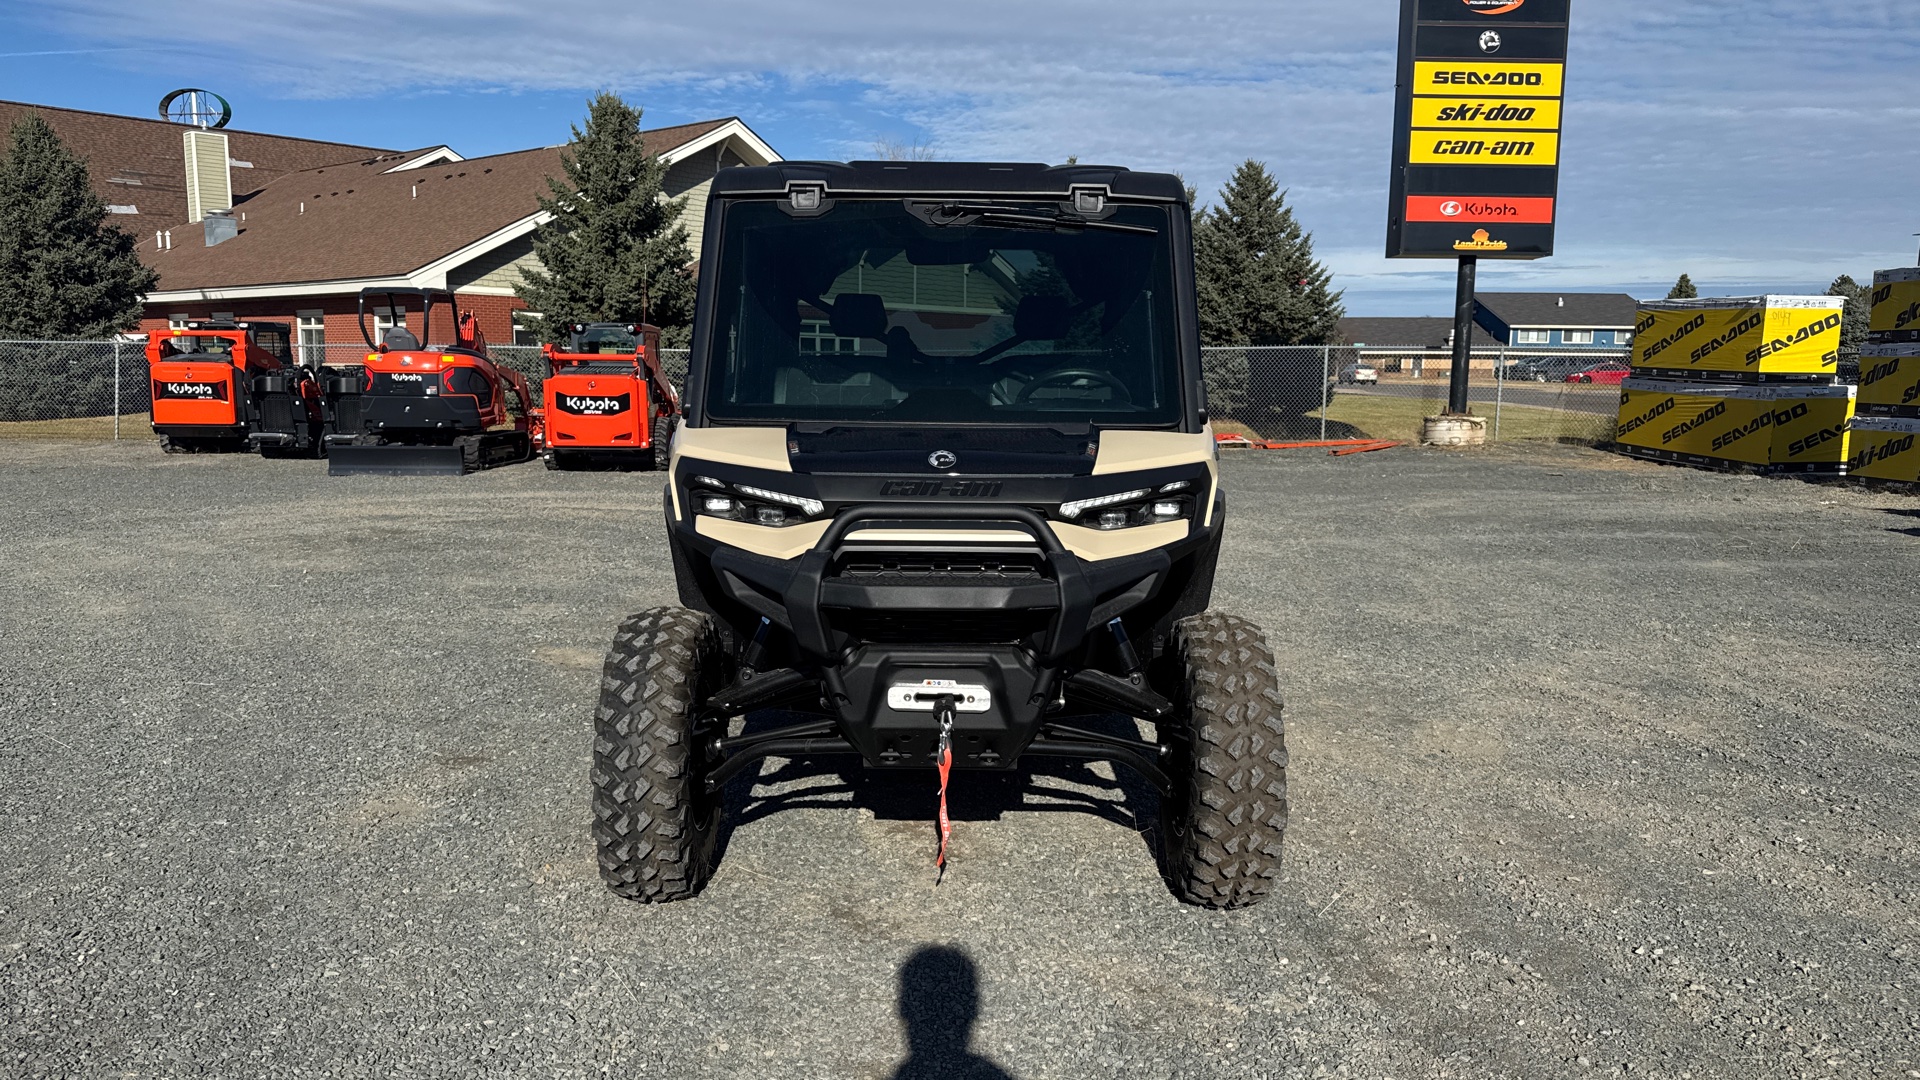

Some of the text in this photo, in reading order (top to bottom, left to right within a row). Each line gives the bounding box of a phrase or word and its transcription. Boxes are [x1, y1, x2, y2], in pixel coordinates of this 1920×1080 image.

[1436, 104, 1536, 121] ski-doo
[1432, 140, 1535, 156] can-am
[1465, 203, 1517, 216] Kubota
[391, 373, 422, 382] Kubota
[167, 382, 213, 395] Kubota
[566, 397, 619, 411] Kubota
[880, 480, 1003, 497] can-am
